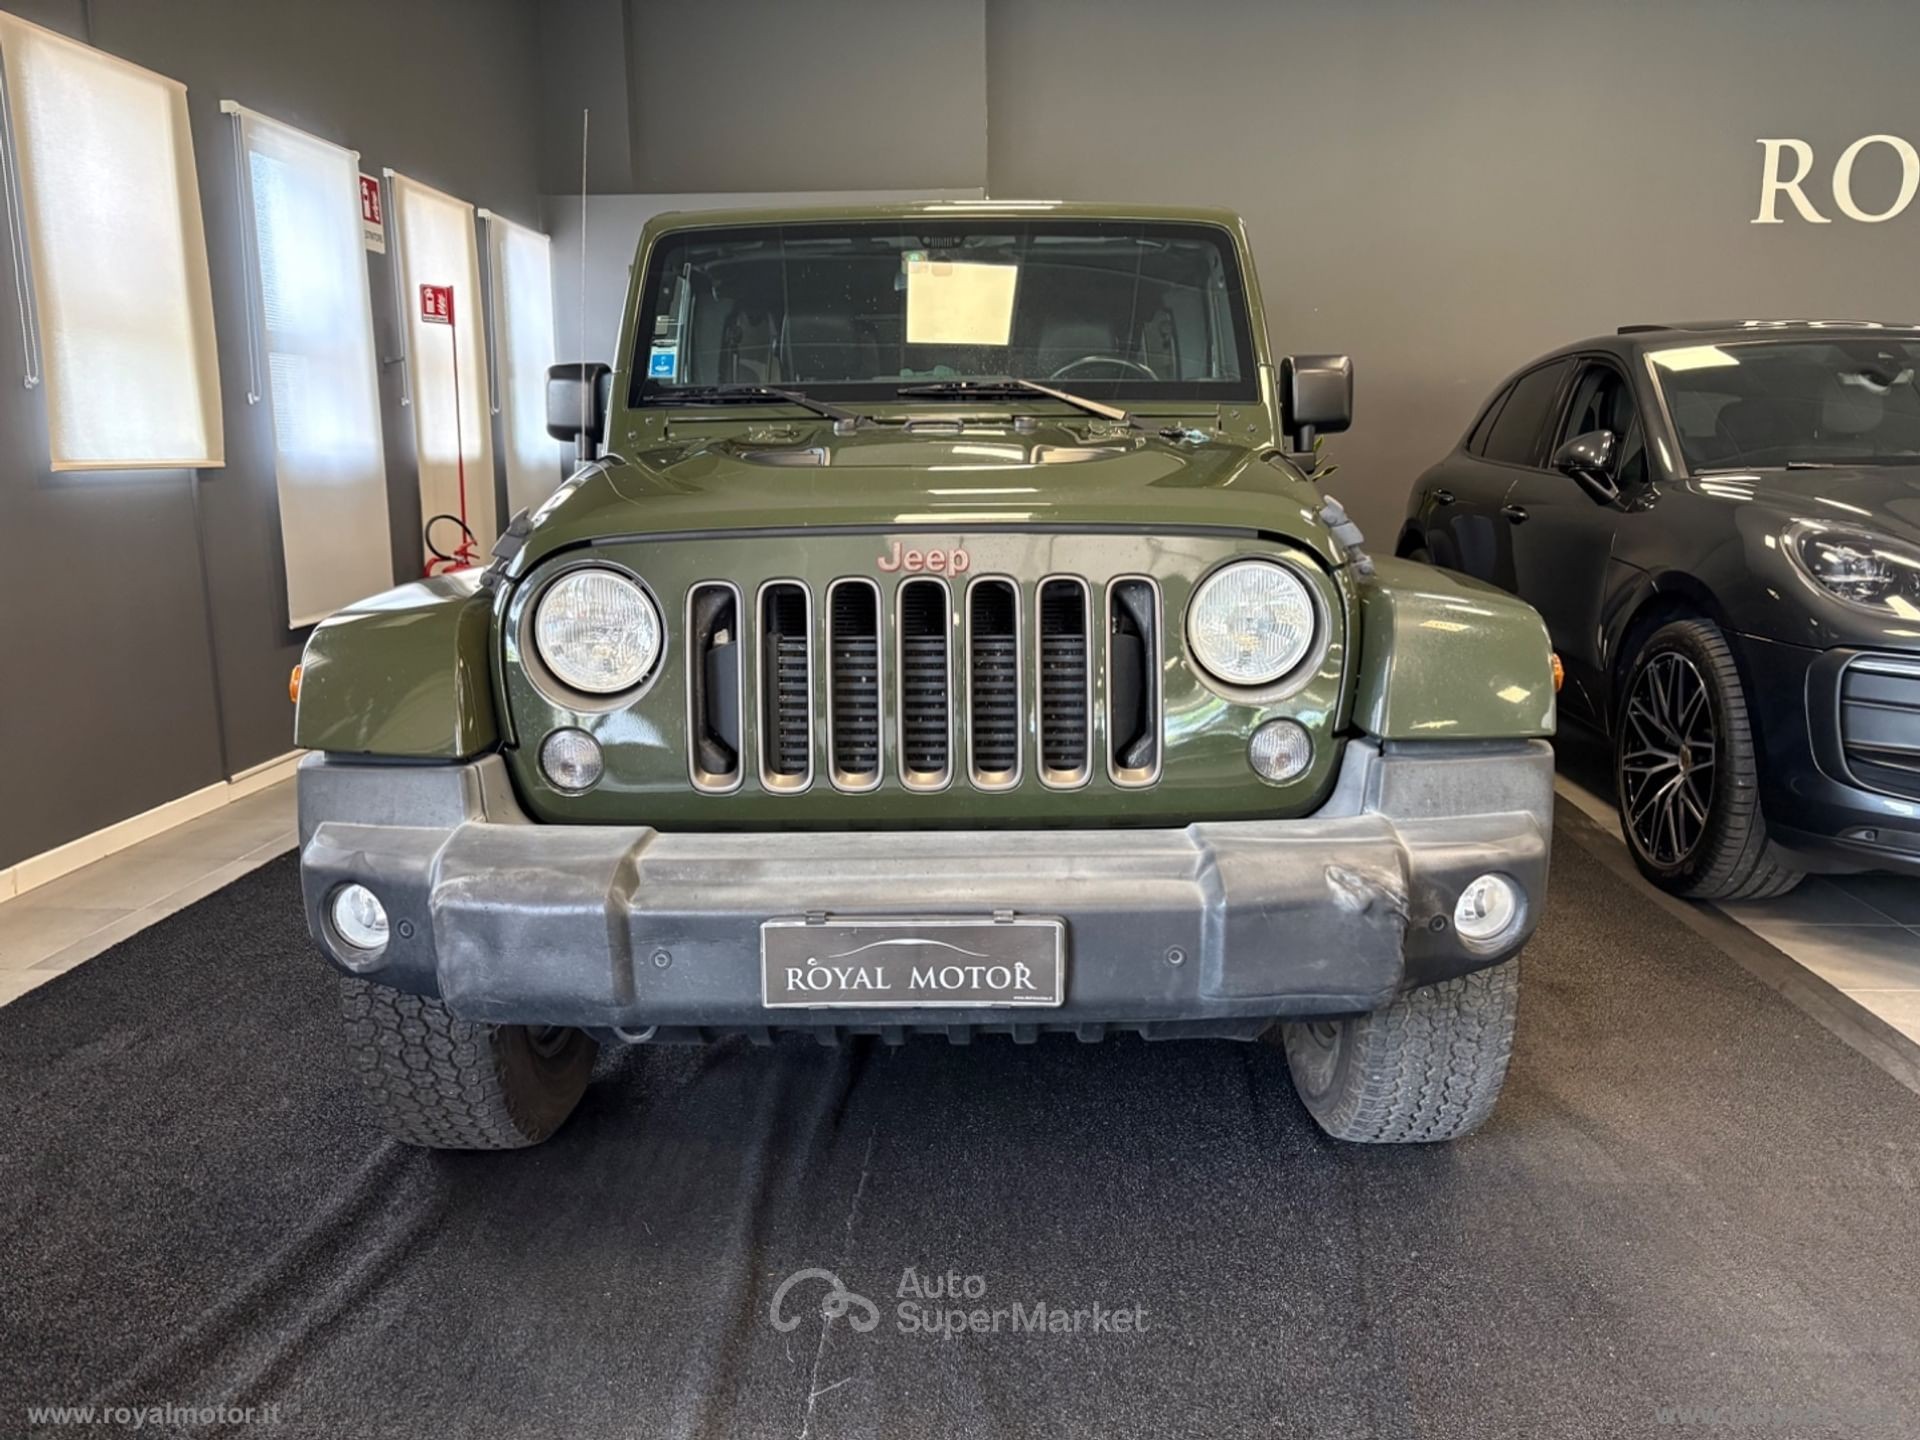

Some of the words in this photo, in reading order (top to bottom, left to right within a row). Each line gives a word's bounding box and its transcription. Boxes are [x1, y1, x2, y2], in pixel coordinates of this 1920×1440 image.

[1750, 134, 1920, 224] RO
[877, 541, 970, 578] Jeep
[785, 966, 892, 991] ROYAL
[908, 966, 1037, 991] MOTOR
